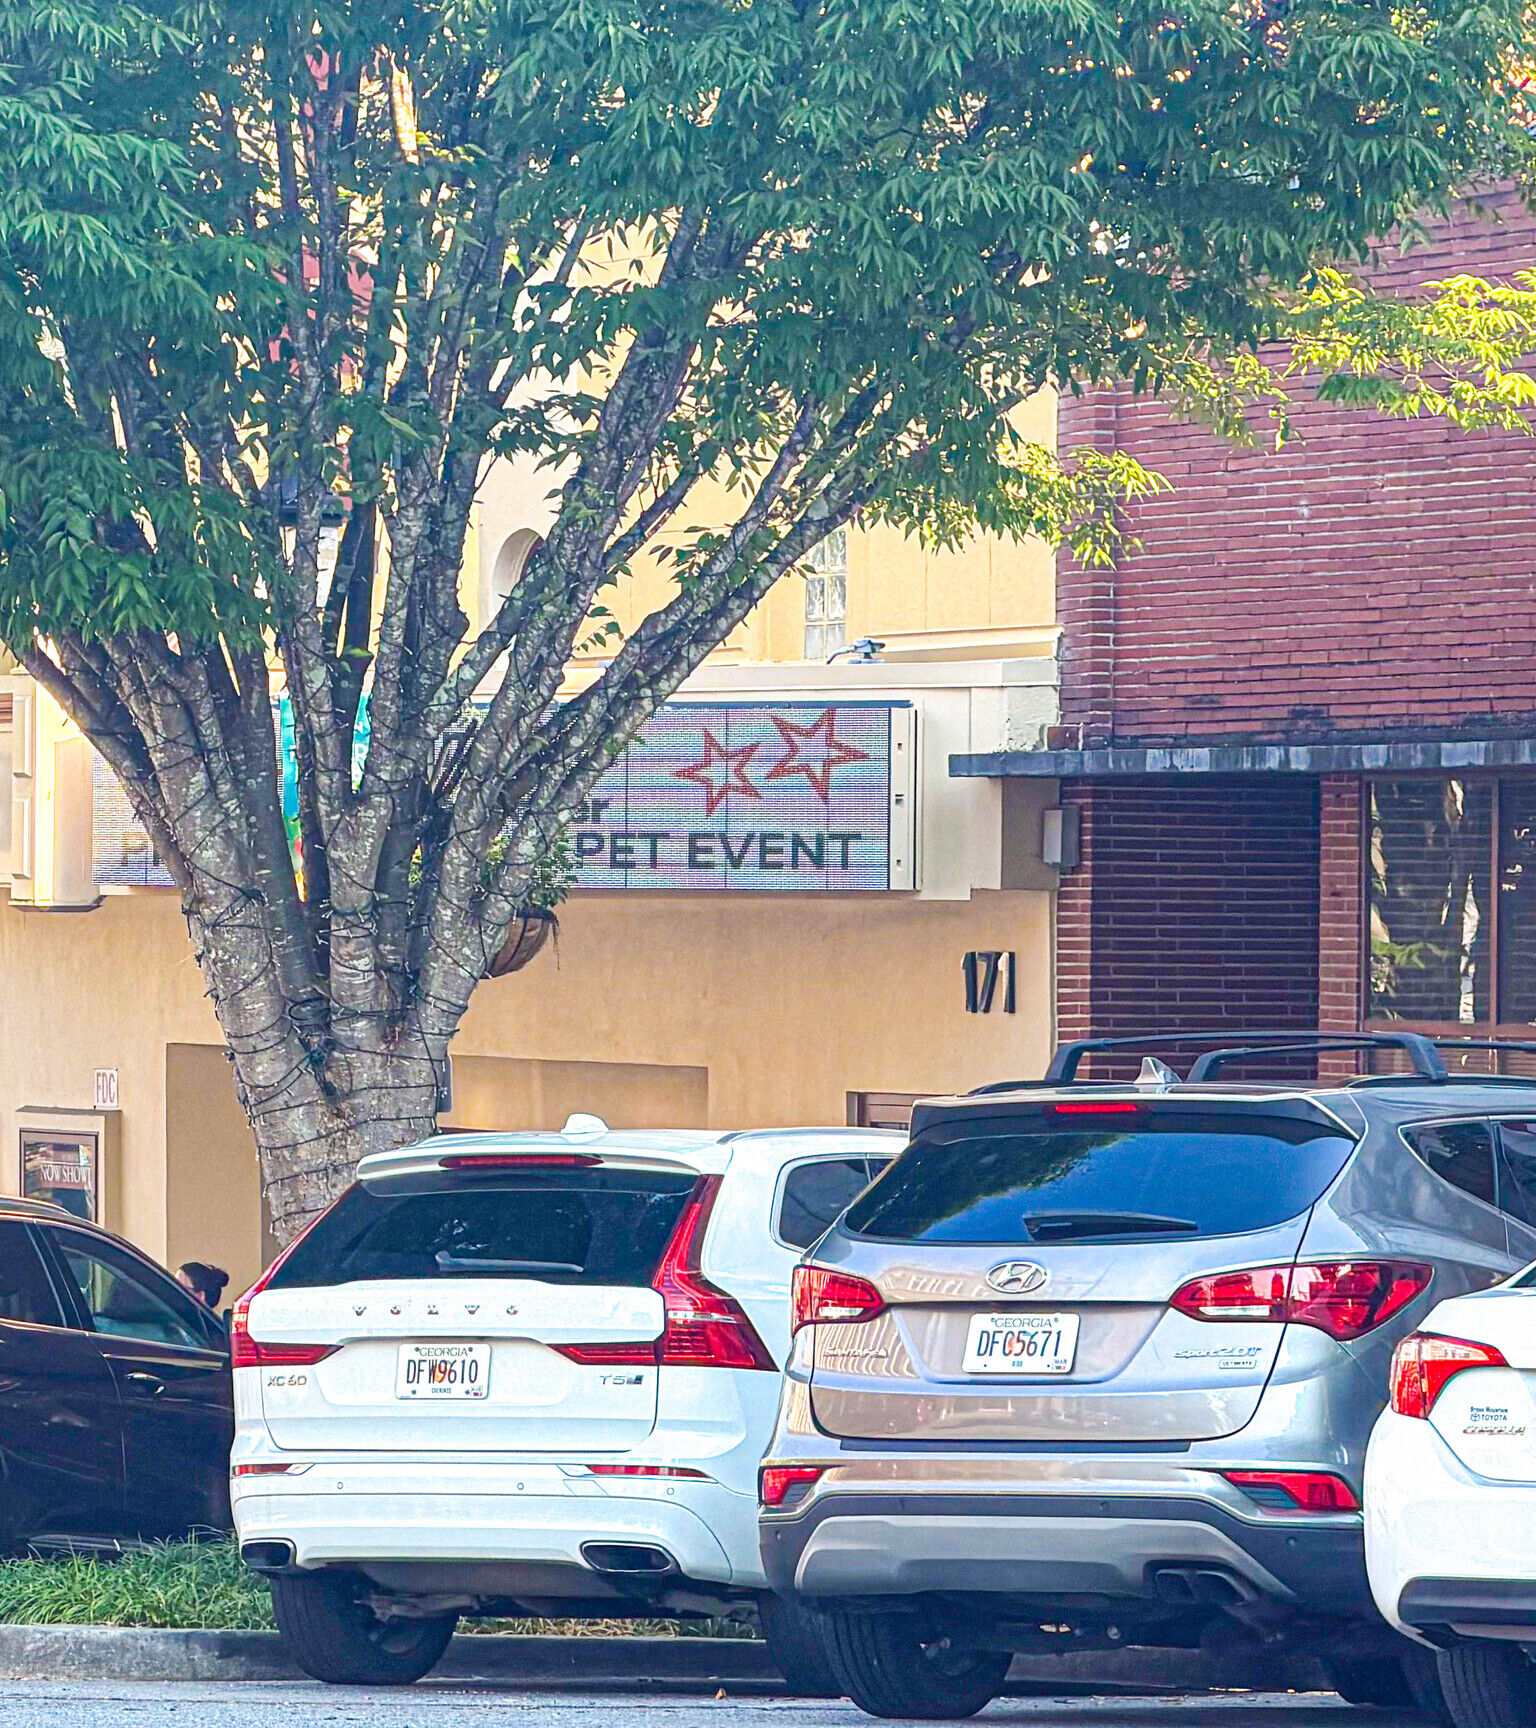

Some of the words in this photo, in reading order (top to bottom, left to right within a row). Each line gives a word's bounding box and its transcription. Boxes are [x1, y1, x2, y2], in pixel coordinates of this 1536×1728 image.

[687, 832, 862, 870] EVENT
[961, 951, 1015, 1013] 171
[96, 1072, 115, 1103] FDC
[41, 1164, 61, 1182] NOW
[994, 1317, 1052, 1328] GEORGIA
[419, 1347, 468, 1357] GEORGIA
[406, 1359, 479, 1384] DFW9610
